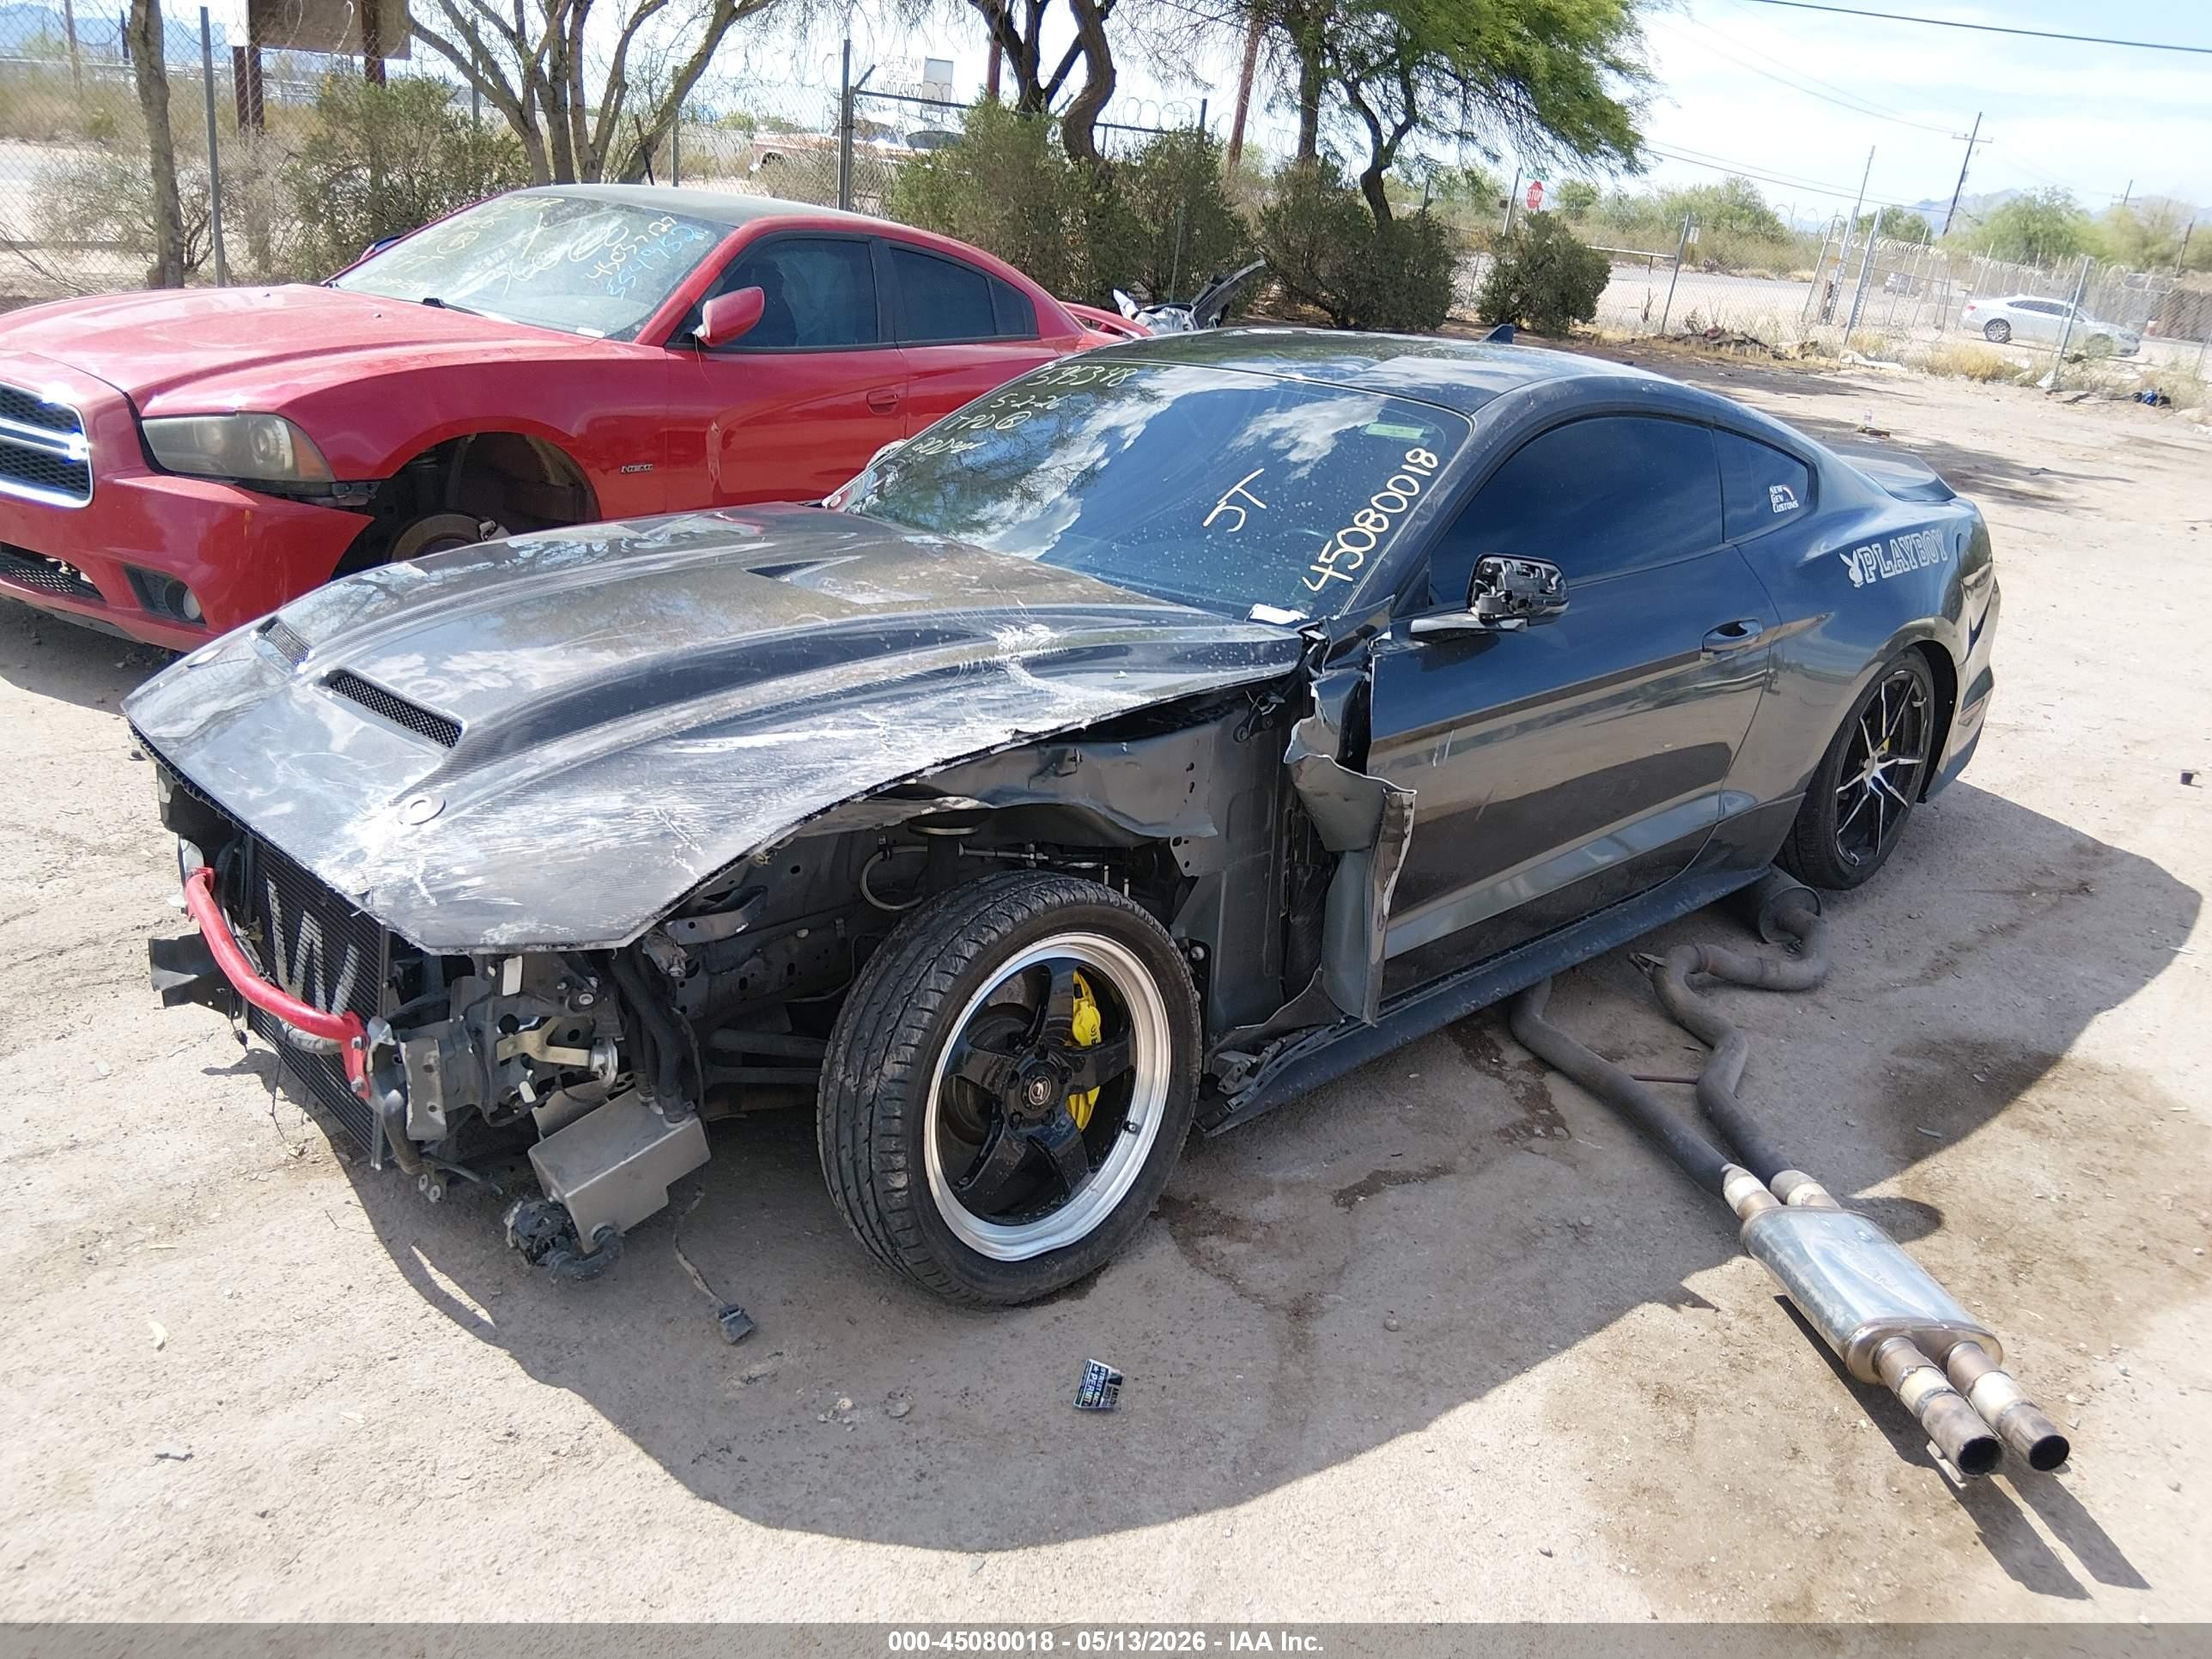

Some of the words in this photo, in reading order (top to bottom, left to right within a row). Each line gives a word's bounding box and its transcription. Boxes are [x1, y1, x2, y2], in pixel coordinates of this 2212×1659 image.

[1528, 189, 1543, 201] STOP
[1769, 484, 1785, 495] NEW
[1303, 447, 1439, 592] 45080018
[1856, 528, 1948, 584] PLAYBOY
[1084, 1372, 1098, 1403] PERMIT
[1095, 1367, 1107, 1391] STREET
